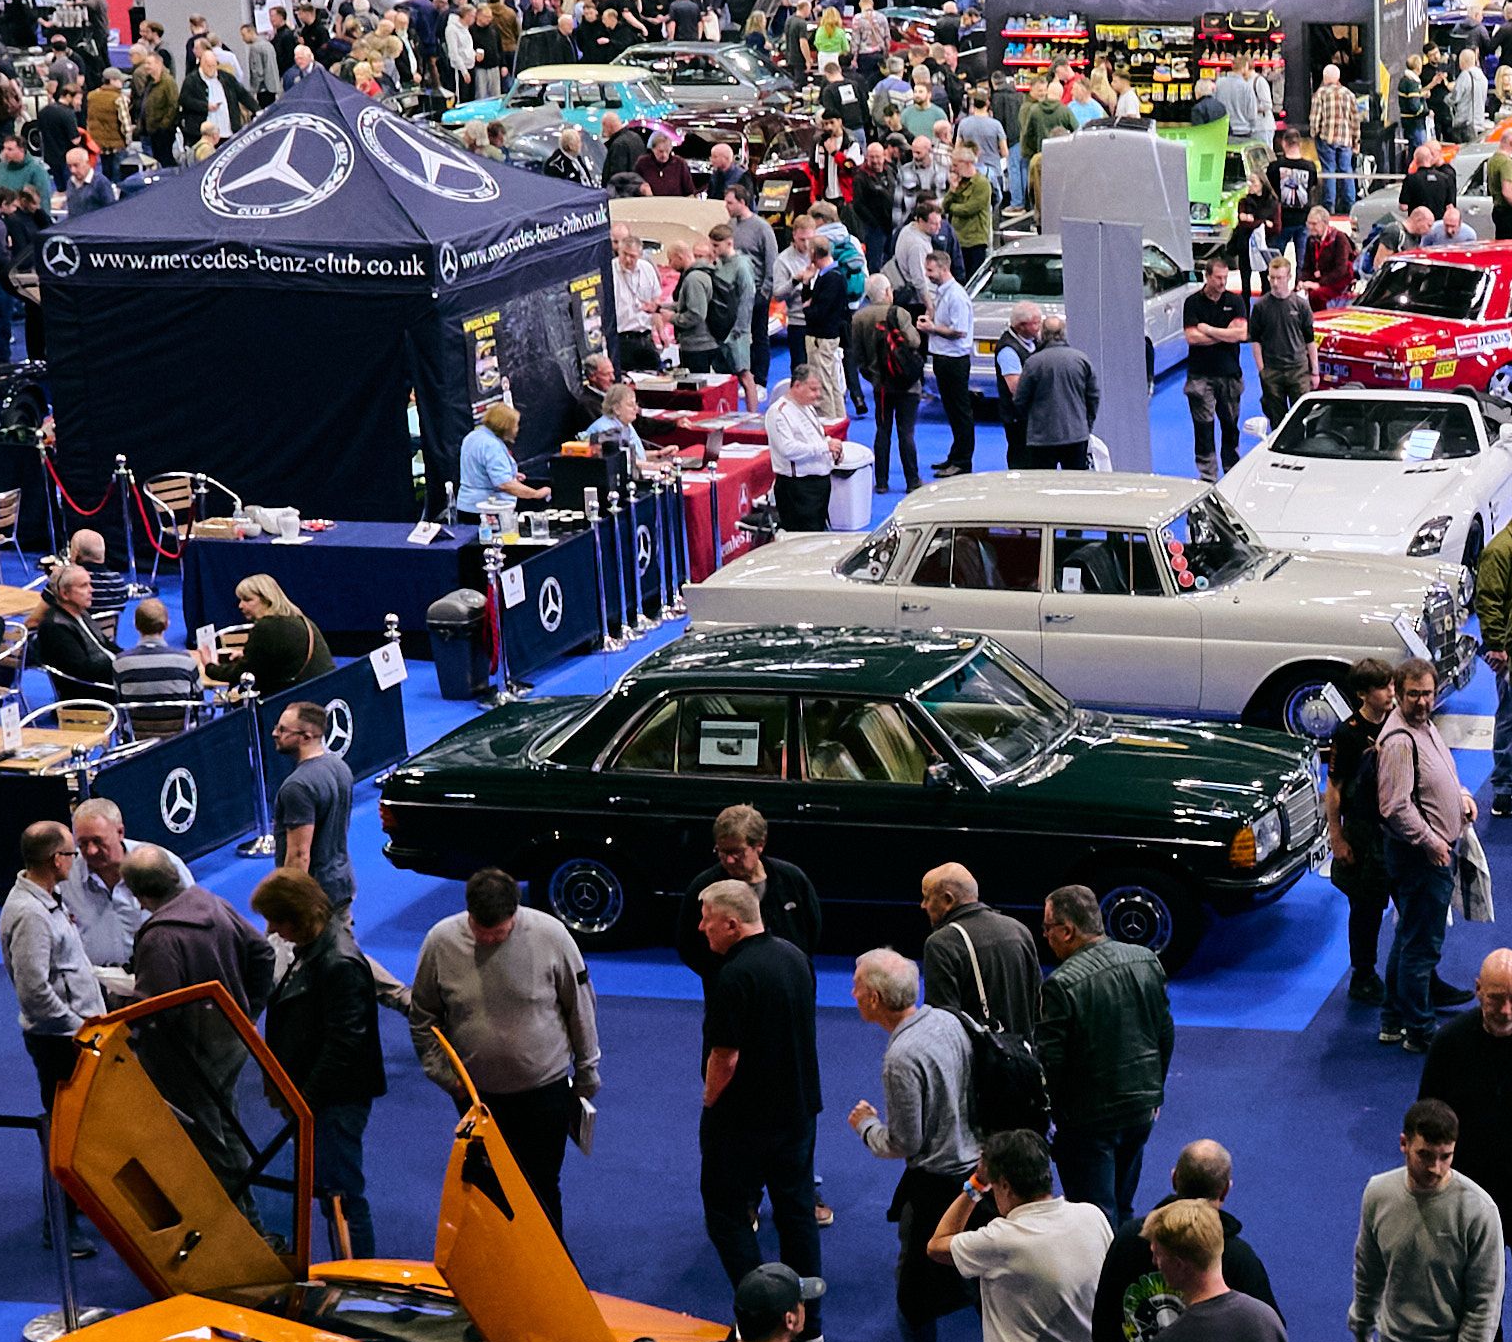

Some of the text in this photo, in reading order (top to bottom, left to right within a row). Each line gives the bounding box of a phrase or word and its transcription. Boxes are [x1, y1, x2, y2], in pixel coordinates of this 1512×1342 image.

[236, 206, 271, 216] CLUB
[89, 250, 426, 279] www.mercedes-benz-club.co.uk
[1479, 330, 1512, 347] JEANS
